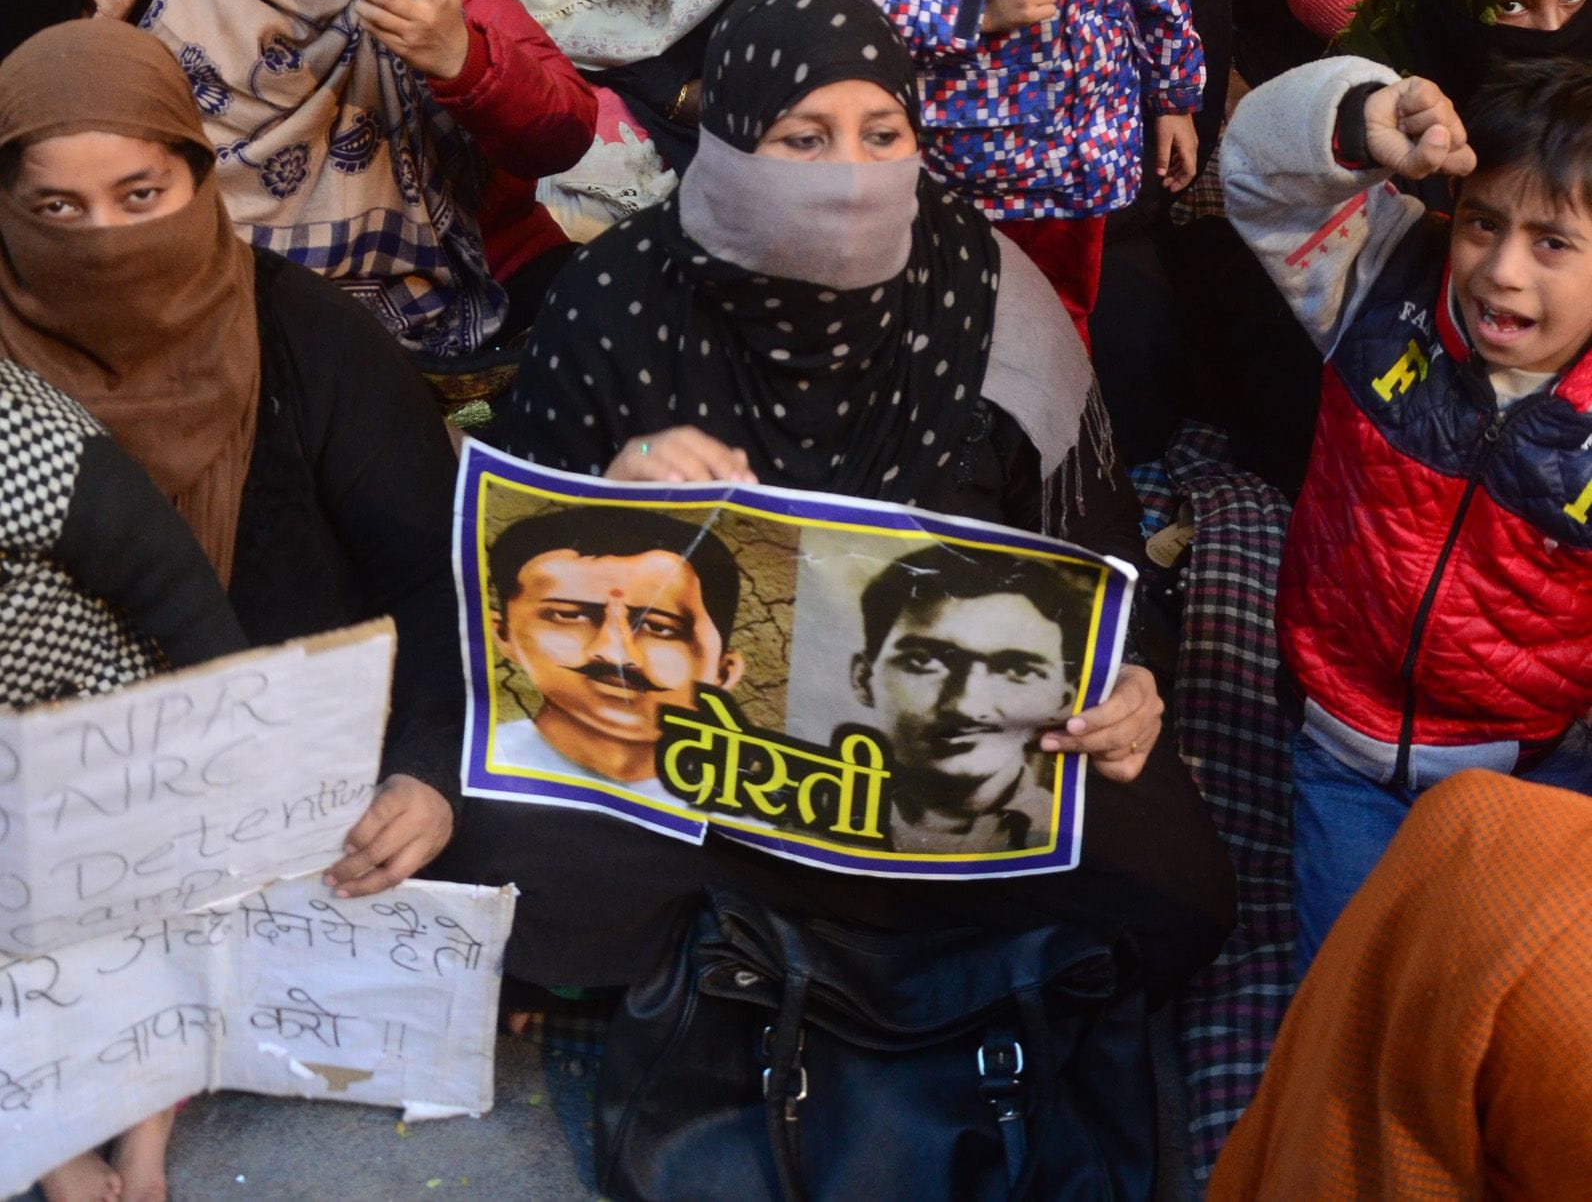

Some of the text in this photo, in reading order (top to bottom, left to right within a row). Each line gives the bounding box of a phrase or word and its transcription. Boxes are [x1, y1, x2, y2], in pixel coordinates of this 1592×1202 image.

[55, 671, 292, 767] NPR
[664, 692, 891, 839] दोस्ती
[52, 736, 256, 833] NRC
[433, 914, 484, 977] तो
[250, 986, 359, 1048] करो
